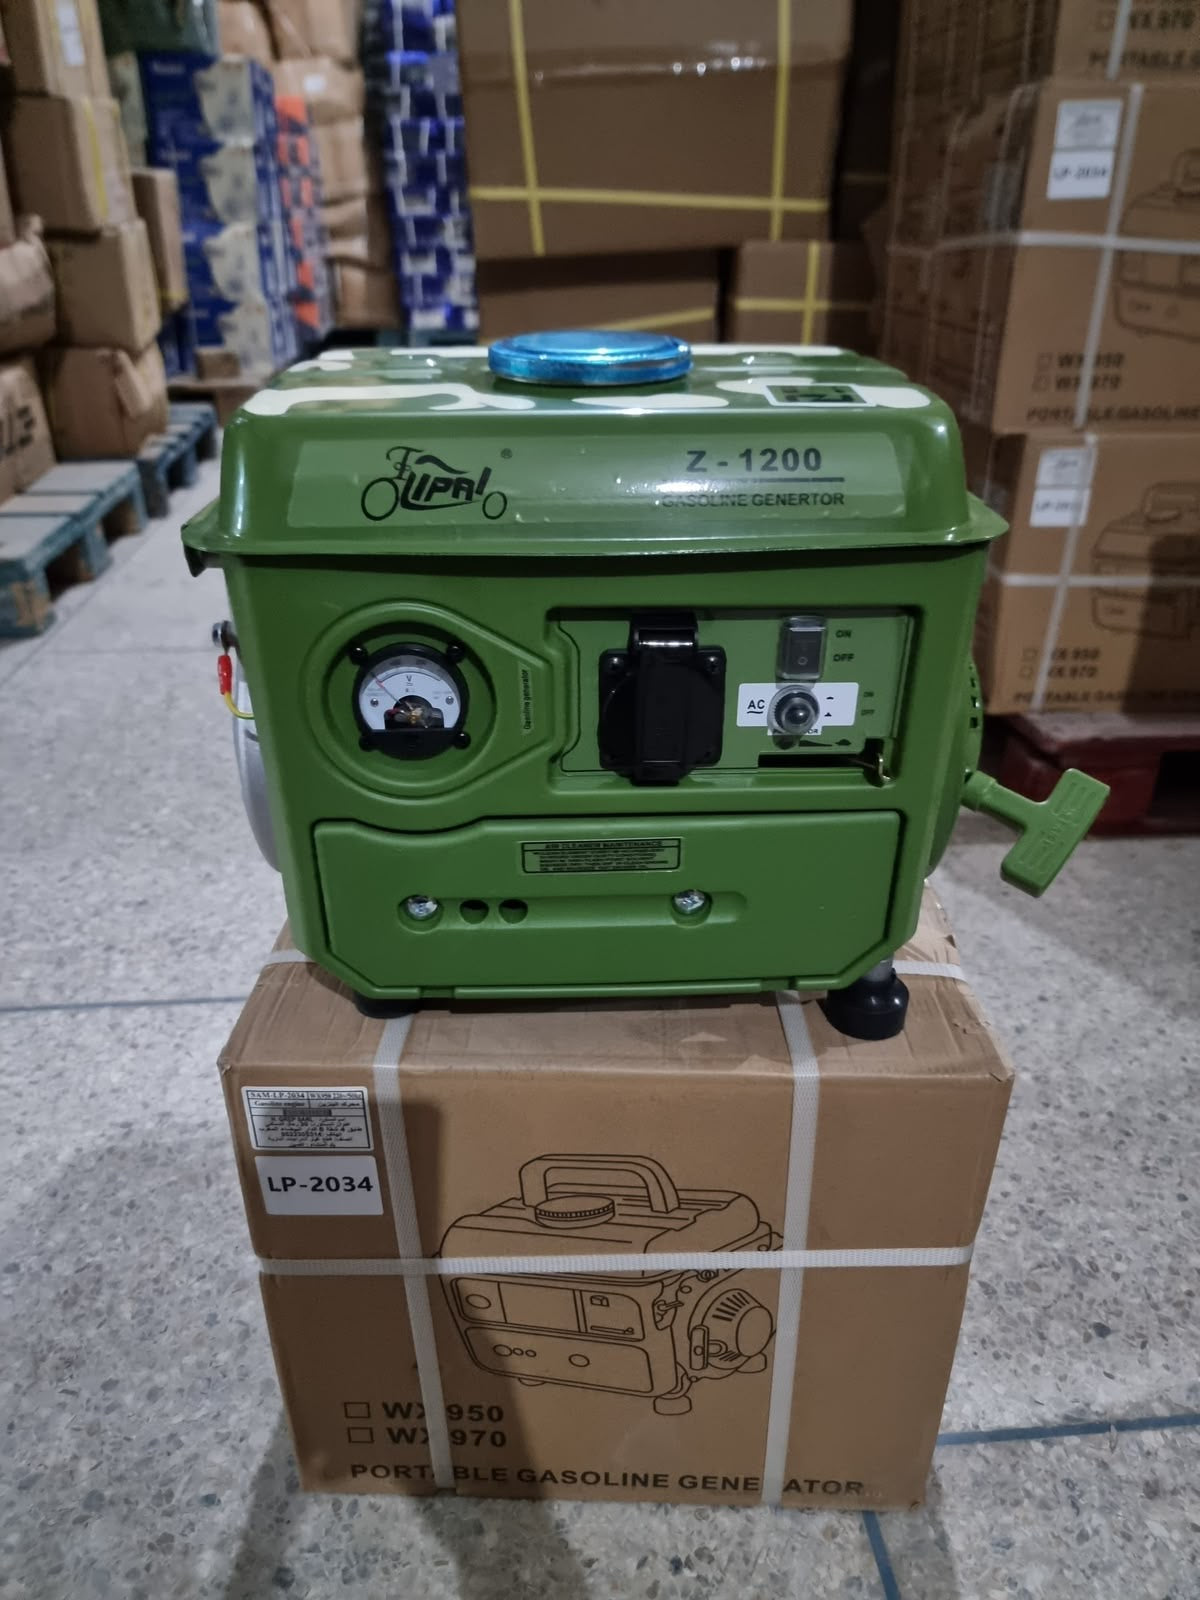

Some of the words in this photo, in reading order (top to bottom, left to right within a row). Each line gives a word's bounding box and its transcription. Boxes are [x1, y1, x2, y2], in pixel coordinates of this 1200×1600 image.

[662, 494, 748, 507] GASOLINE
[752, 493, 845, 507] GENERTOR
[836, 629, 852, 638] ON
[833, 653, 854, 662] OFF
[747, 699, 766, 710] AC
[267, 1176, 373, 1192] LP-2034
[446, 1404, 504, 1422] 950
[450, 1429, 507, 1448] 970
[351, 1464, 508, 1482] PORTBLE
[516, 1468, 669, 1488] GASOLINE
[678, 1475, 865, 1496] GENEATOR
